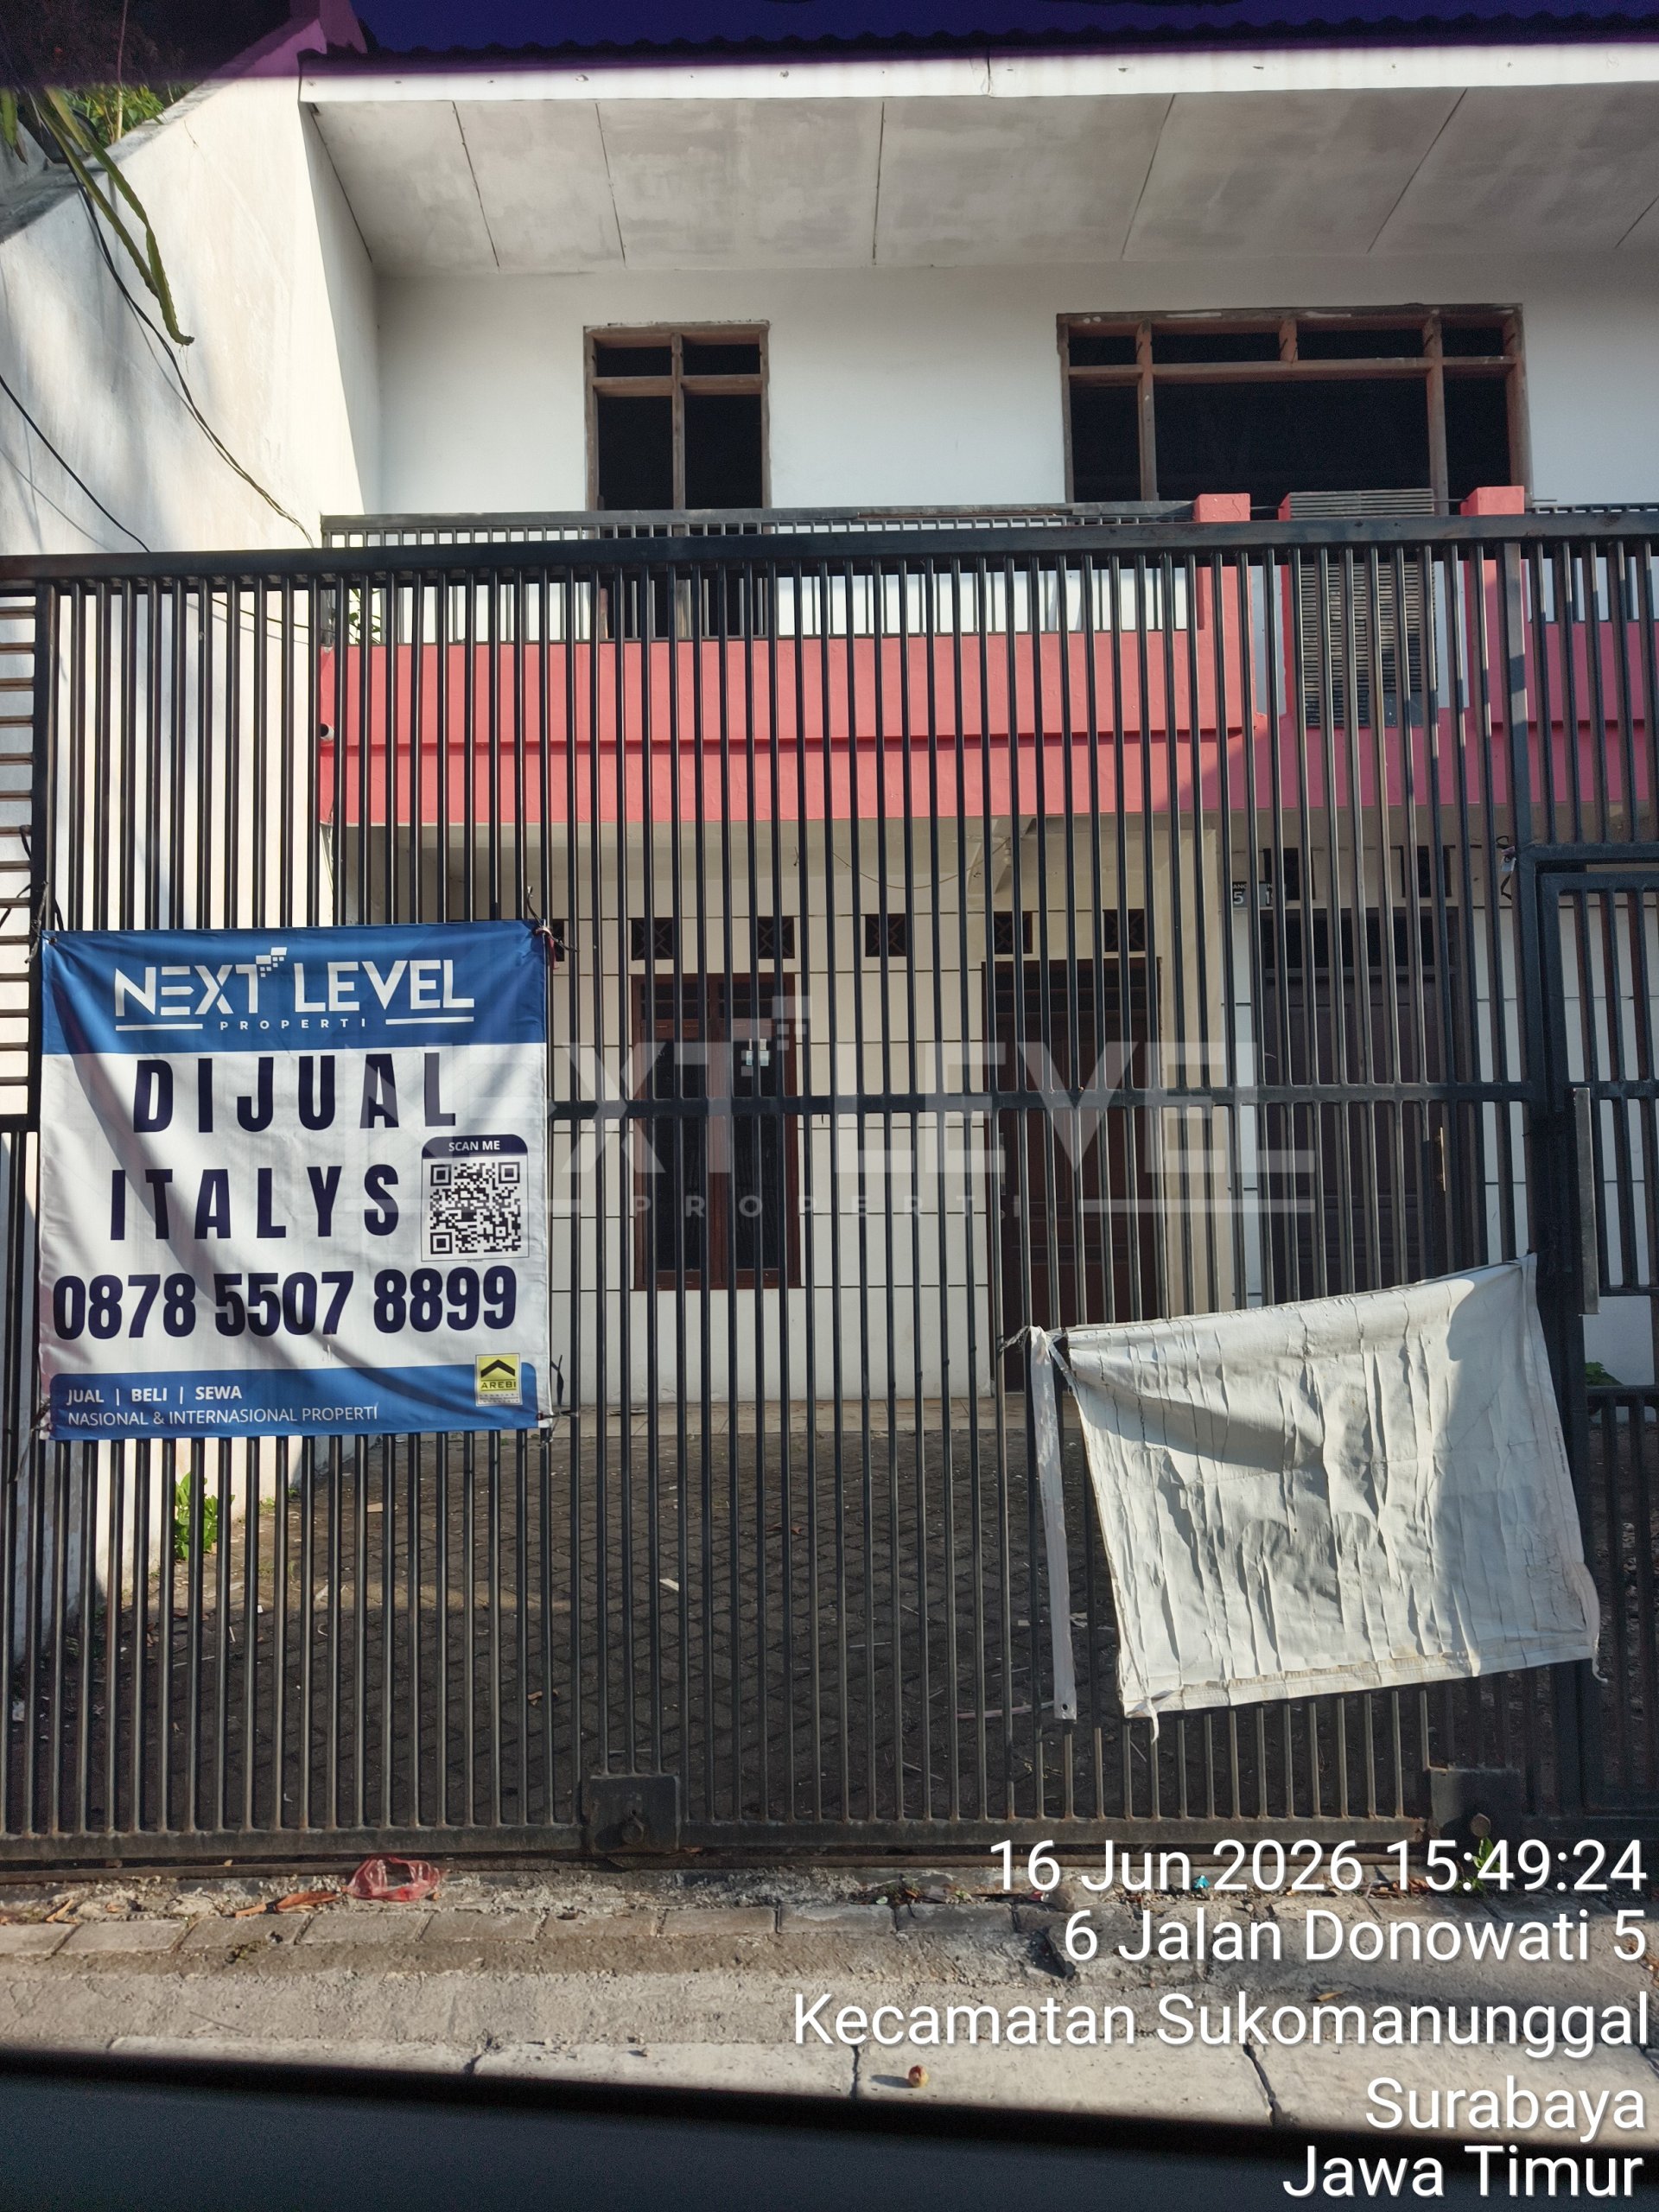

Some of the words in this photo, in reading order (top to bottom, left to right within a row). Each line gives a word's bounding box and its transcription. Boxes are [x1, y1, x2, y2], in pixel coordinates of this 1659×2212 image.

[114, 962, 258, 1017] NEXT
[293, 959, 475, 1013] LEVEL
[219, 1018, 366, 1031] PROPERTI
[133, 1052, 457, 1134] DIJUAL
[448, 1141, 480, 1152] SCAN
[482, 1140, 501, 1151] ME
[110, 1163, 400, 1242] ITALYS
[53, 1274, 197, 1340] 0878
[214, 1271, 354, 1338] 5507
[373, 1265, 518, 1334] 8899
[67, 1389, 105, 1406] JUAL
[131, 1388, 168, 1402] BELI
[194, 1385, 243, 1401] SEWA
[480, 1381, 517, 1389] AREBI
[68, 1411, 149, 1427] NASIONAL
[153, 1411, 165, 1425] &
[169, 1407, 298, 1425] INTERNASIONAL
[302, 1405, 378, 1421] PROPERTI
